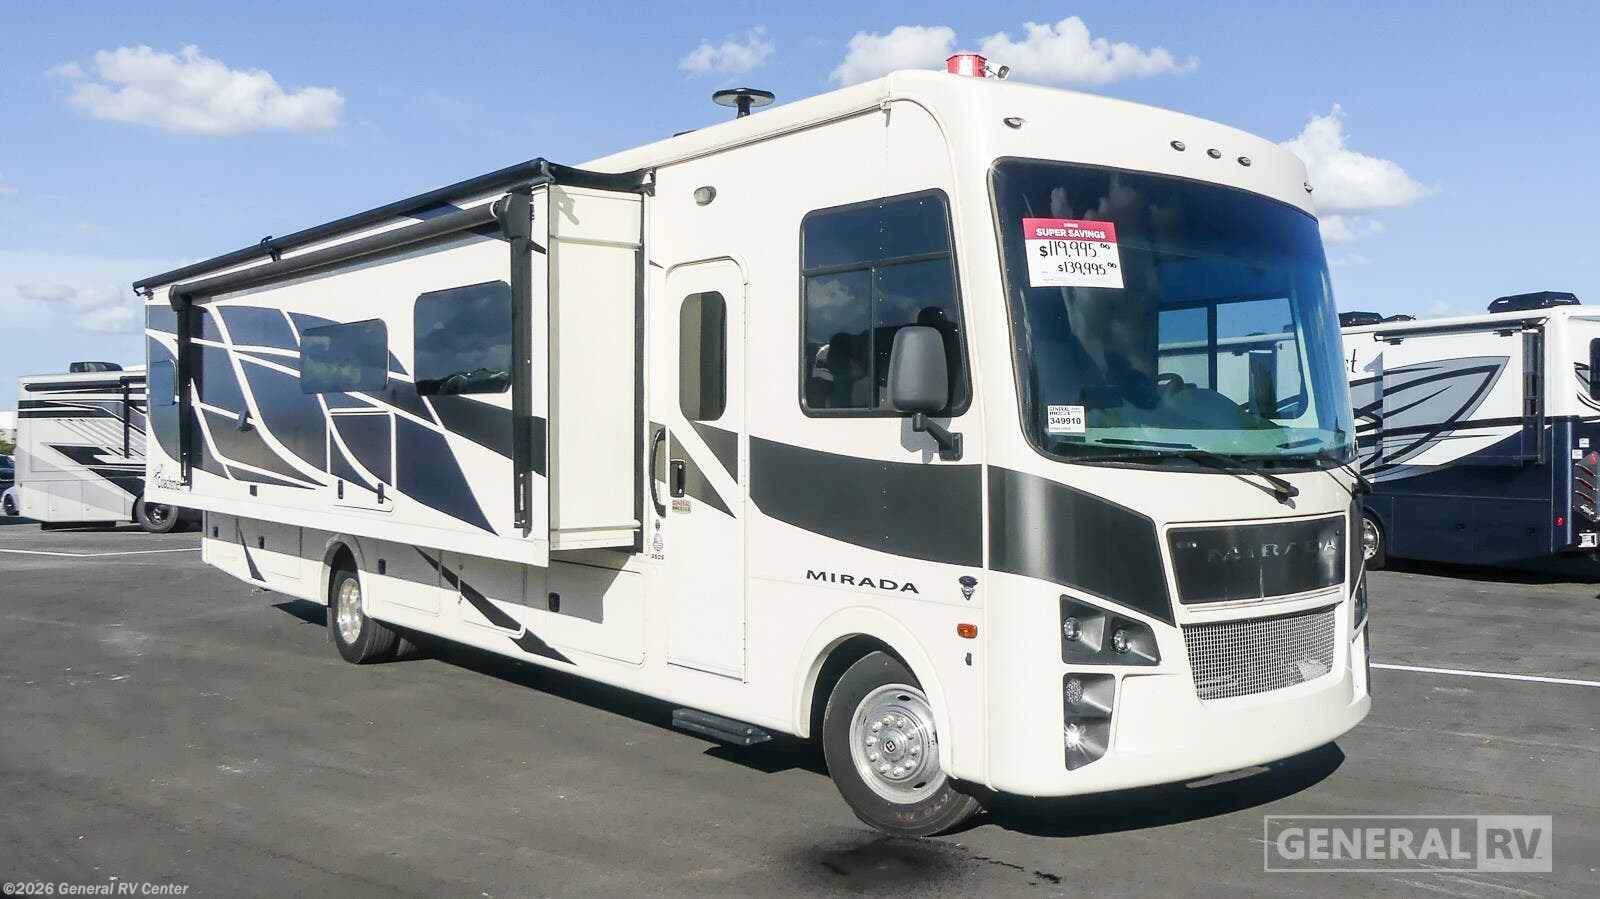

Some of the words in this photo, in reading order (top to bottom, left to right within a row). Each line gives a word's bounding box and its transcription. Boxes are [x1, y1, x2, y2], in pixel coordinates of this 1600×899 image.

[1036, 228, 1066, 237] SUPER
[1068, 229, 1106, 239] SAVINGS
[1049, 417, 1081, 425] 349910
[806, 569, 920, 594] MIRADA
